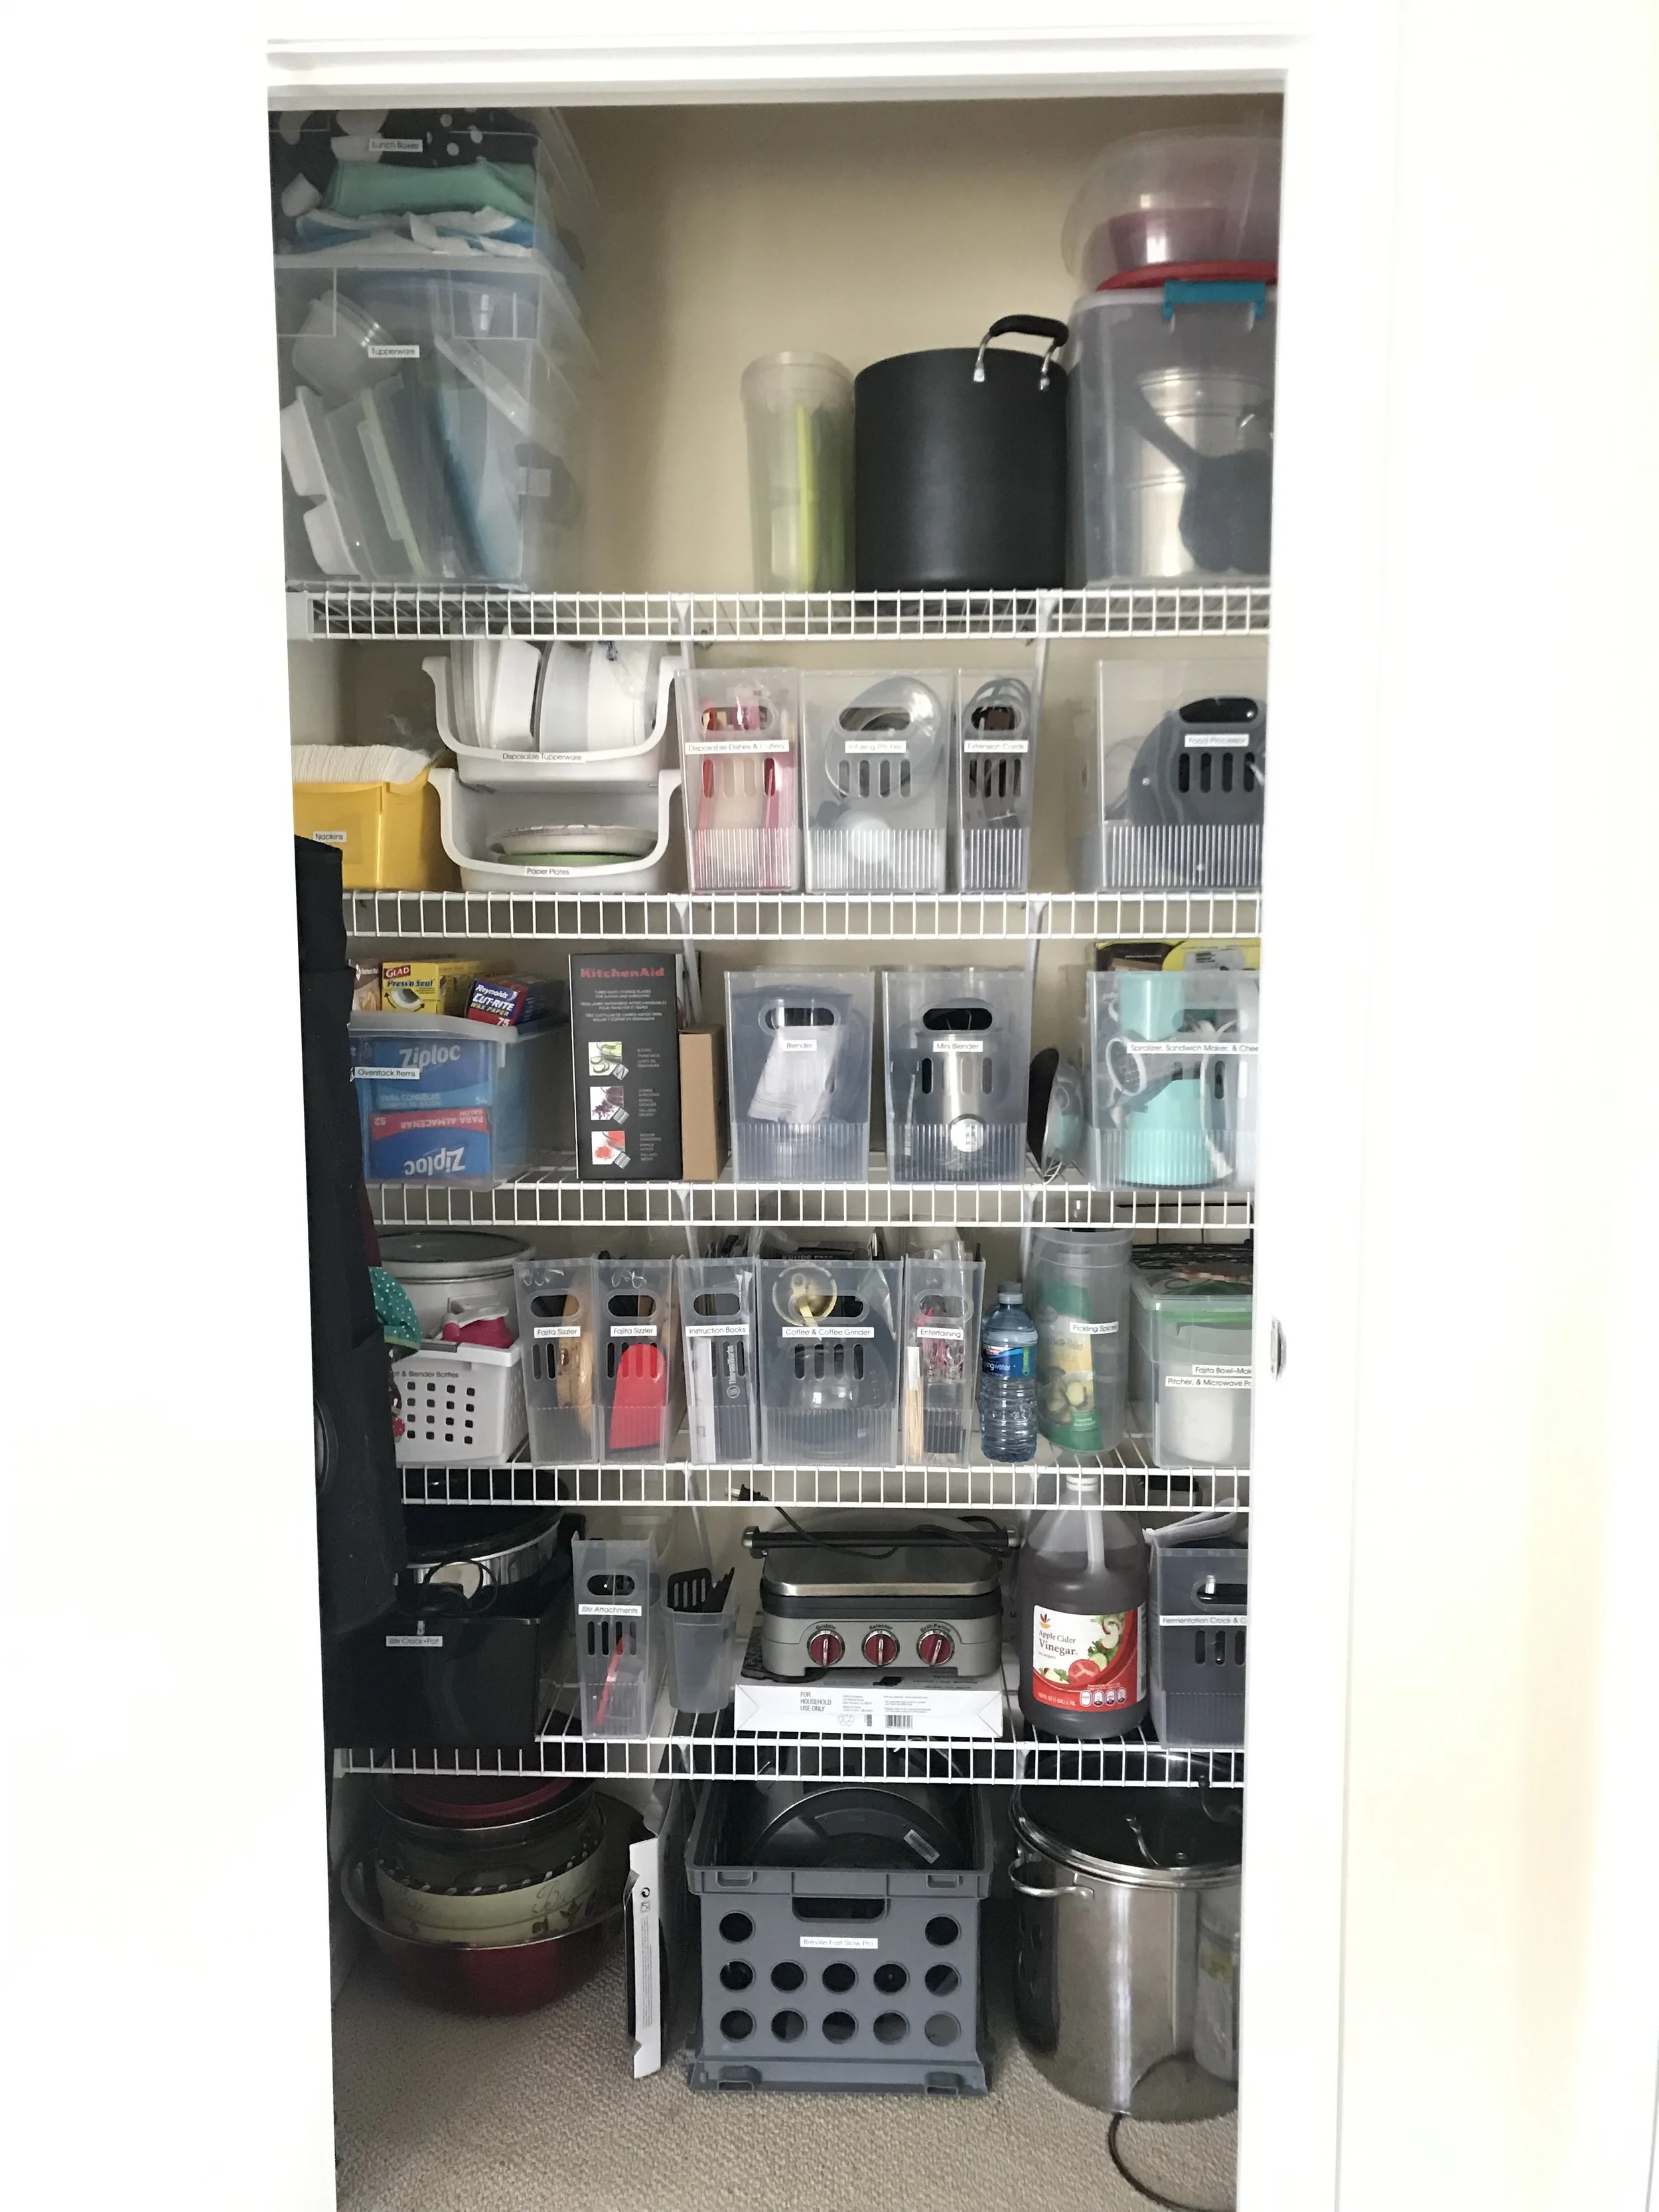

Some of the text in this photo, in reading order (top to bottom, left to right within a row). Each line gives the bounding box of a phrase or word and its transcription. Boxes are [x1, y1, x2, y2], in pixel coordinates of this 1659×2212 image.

[688, 744, 727, 753] Disposable
[386, 966, 410, 978] GLAD
[580, 966, 665, 978] KitchenAid
[475, 984, 509, 999] Reynolds
[472, 993, 516, 1011] CUT-RITE
[470, 1001, 510, 1017] WAX PAPER
[496, 1017, 511, 1027] 75
[399, 1044, 461, 1074] Ziploc
[358, 1068, 416, 1077] Overstock Items
[374, 1116, 386, 1126] 52
[400, 1117, 457, 1129] ALMACENAR
[403, 1146, 466, 1177] Ziploc
[920, 1329, 962, 1339] Entertaining
[1073, 1324, 1098, 1333] Pickling
[408, 1370, 435, 1378] Blender
[1039, 1630, 1077, 1644] Apple Cider
[1039, 1638, 1076, 1656] Vinegar
